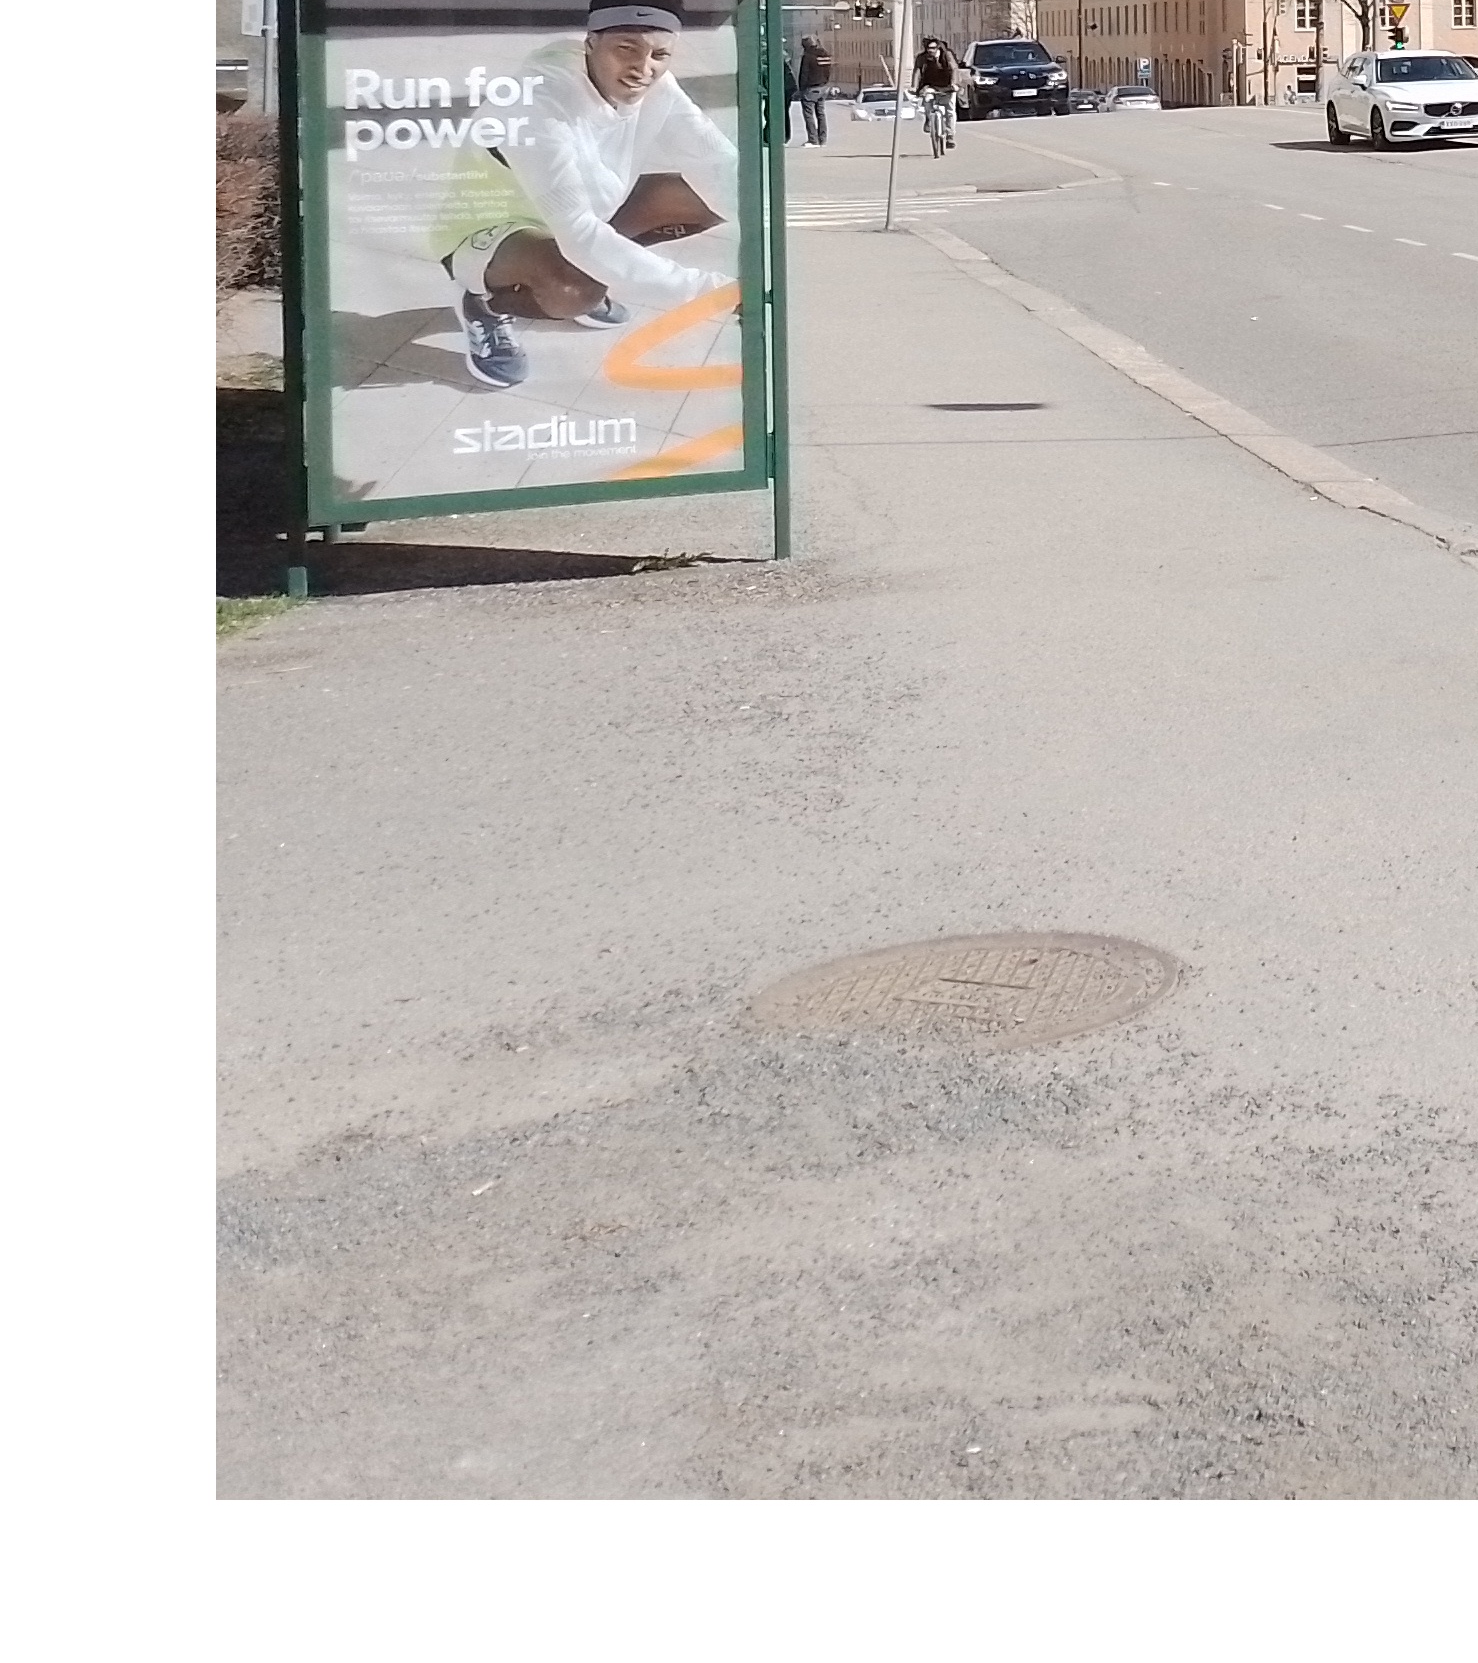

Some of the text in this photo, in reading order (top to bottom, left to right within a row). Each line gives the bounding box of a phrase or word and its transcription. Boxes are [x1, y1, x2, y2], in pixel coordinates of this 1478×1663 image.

[344, 66, 544, 110] Run for
[344, 116, 536, 162] power.
[452, 415, 638, 455] stadium
[551, 449, 571, 459] the
[574, 445, 637, 457] movement
